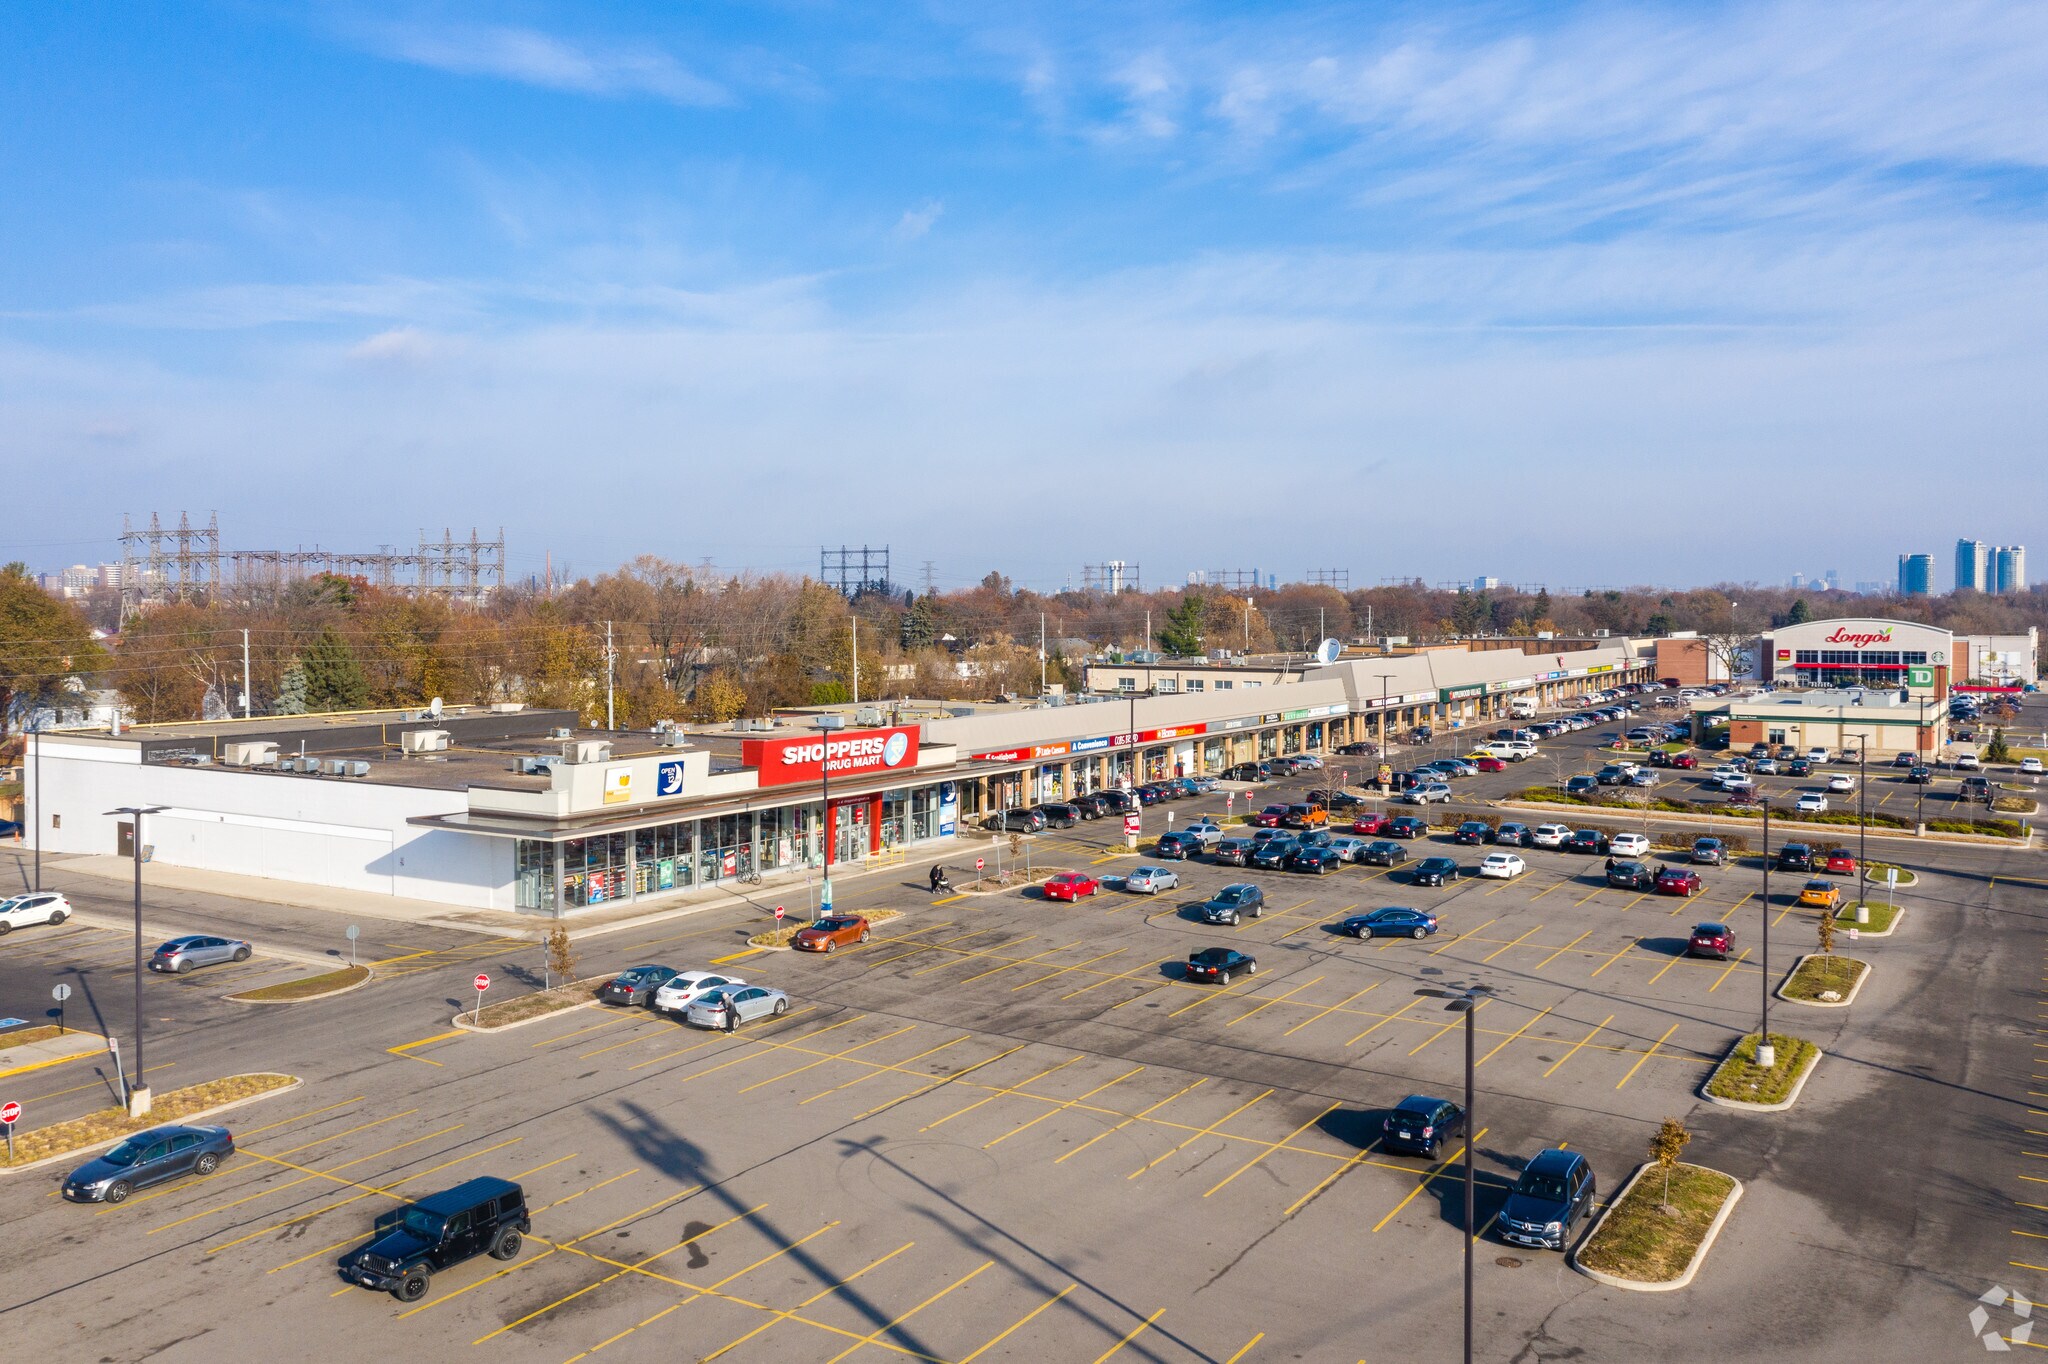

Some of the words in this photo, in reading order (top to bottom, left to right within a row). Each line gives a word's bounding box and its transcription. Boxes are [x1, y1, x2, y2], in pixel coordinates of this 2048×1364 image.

[1912, 670, 1932, 683] TD
[1077, 739, 1108, 750] Convenience
[781, 737, 885, 765] SHOPPERS
[853, 755, 882, 768] MART
[660, 767, 676, 775] OPEN
[668, 775, 675, 783] 12
[1, 1107, 20, 1118] STOP
